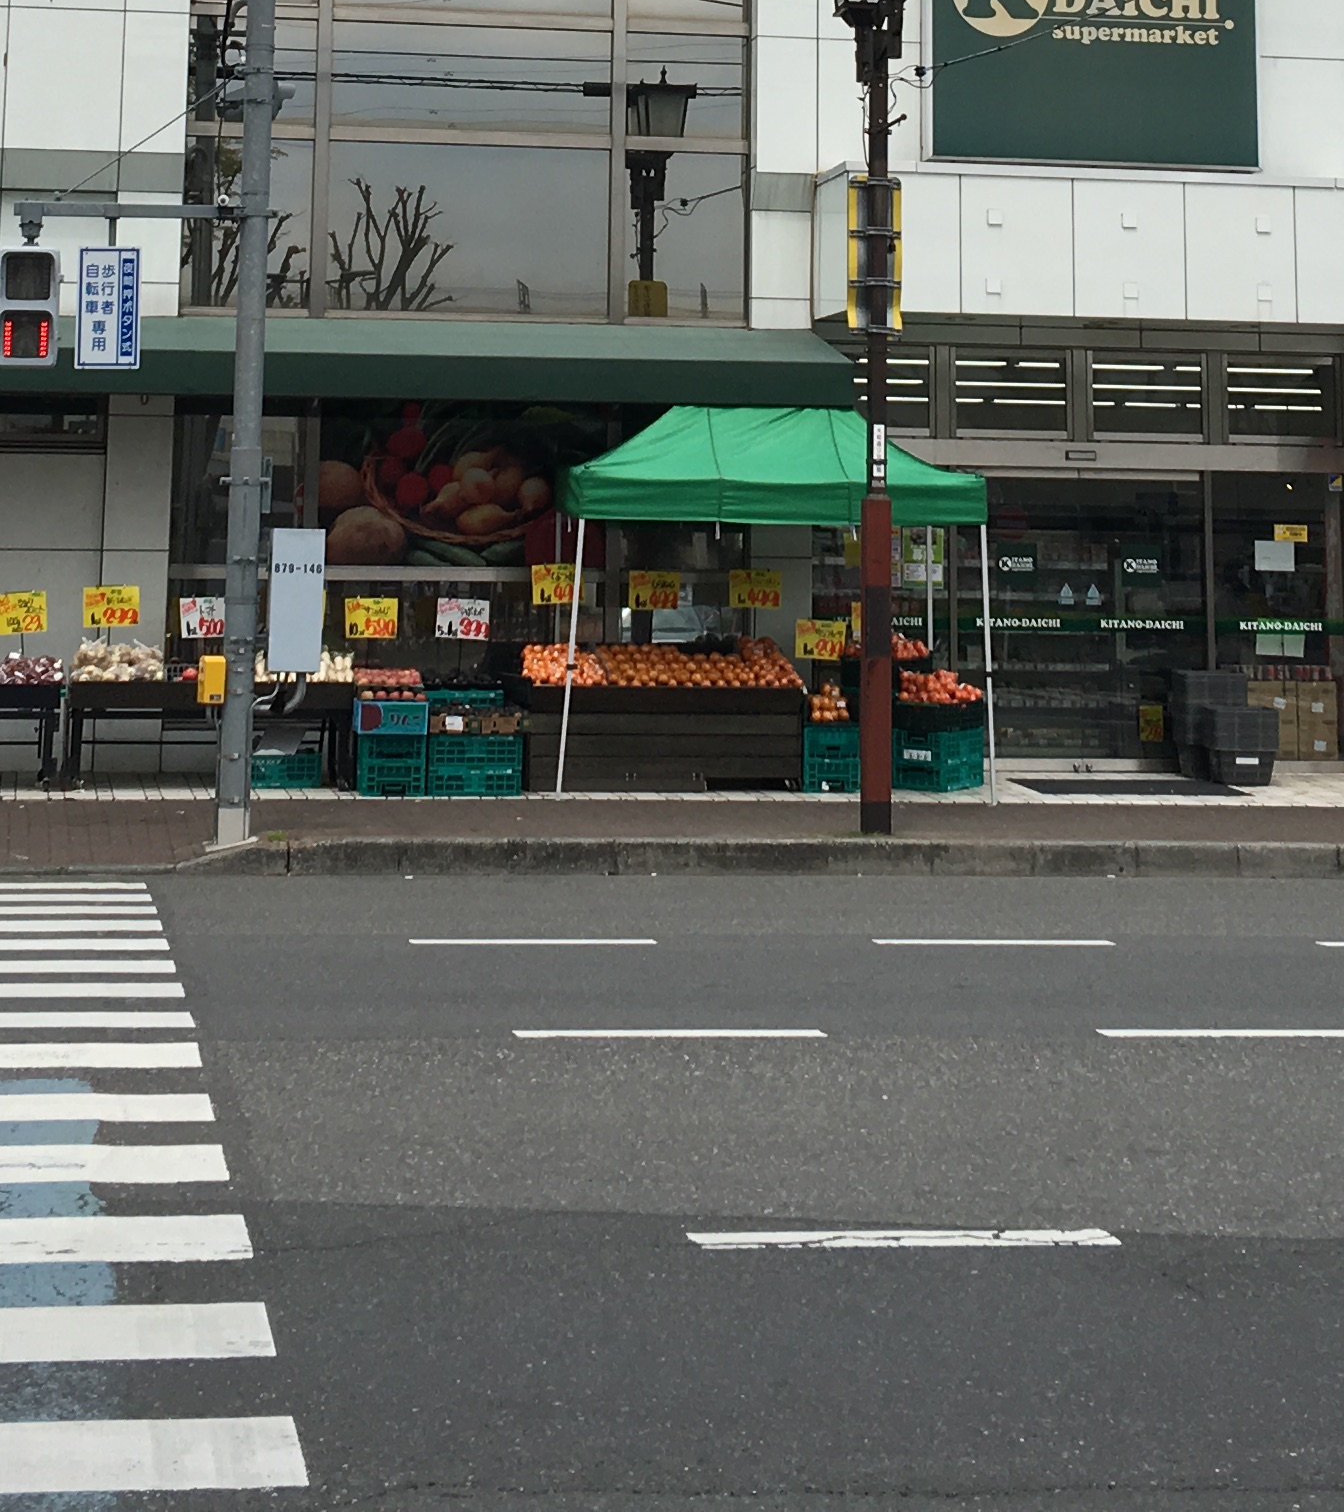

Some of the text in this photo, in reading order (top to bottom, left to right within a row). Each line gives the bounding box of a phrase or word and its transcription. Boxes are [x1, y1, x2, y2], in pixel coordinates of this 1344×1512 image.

[1051, 23, 1220, 46] supermarket
[976, 617, 1061, 628] KTANO-DAICHI
[1100, 618, 1185, 630] KITANO-DAICHI
[1239, 620, 1323, 632] KITANO-DAICHI
